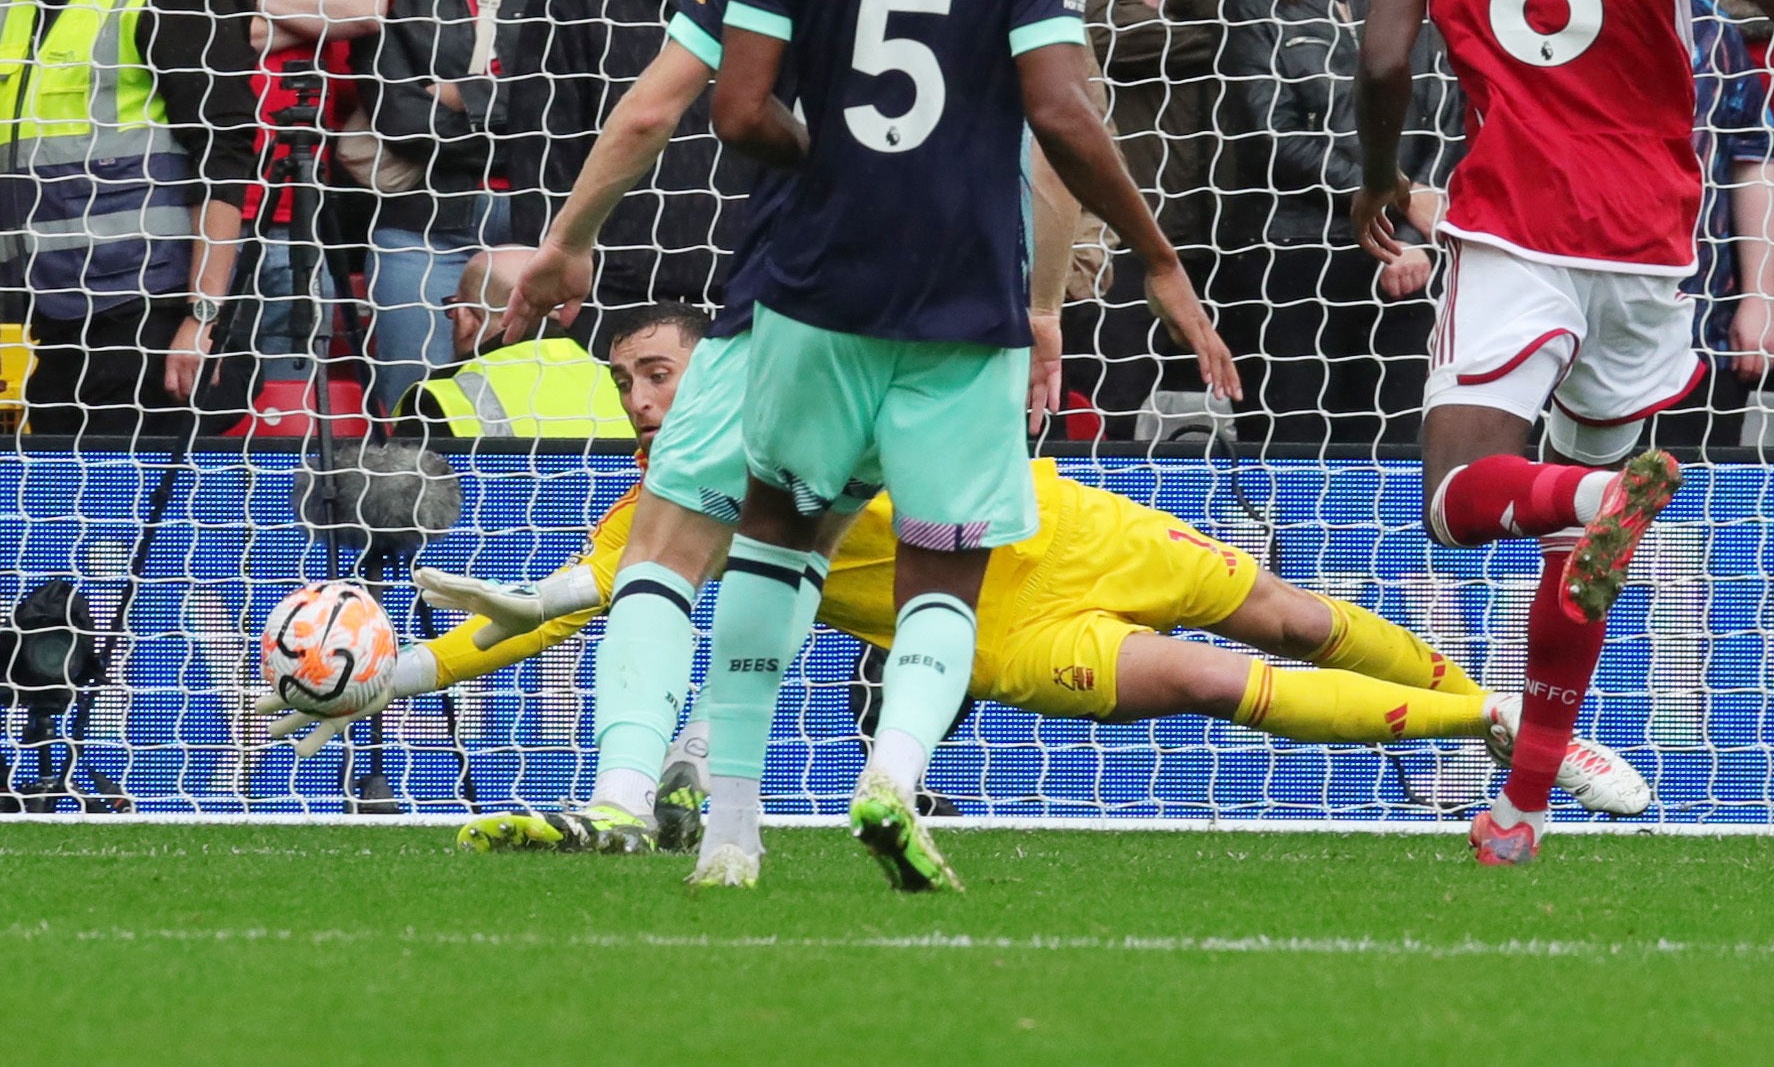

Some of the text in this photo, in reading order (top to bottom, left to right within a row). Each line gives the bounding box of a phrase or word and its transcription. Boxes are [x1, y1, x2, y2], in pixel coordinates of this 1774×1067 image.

[728, 657, 779, 673] BEES
[898, 653, 947, 675] BEES
[1524, 677, 1578, 706] NFFC
